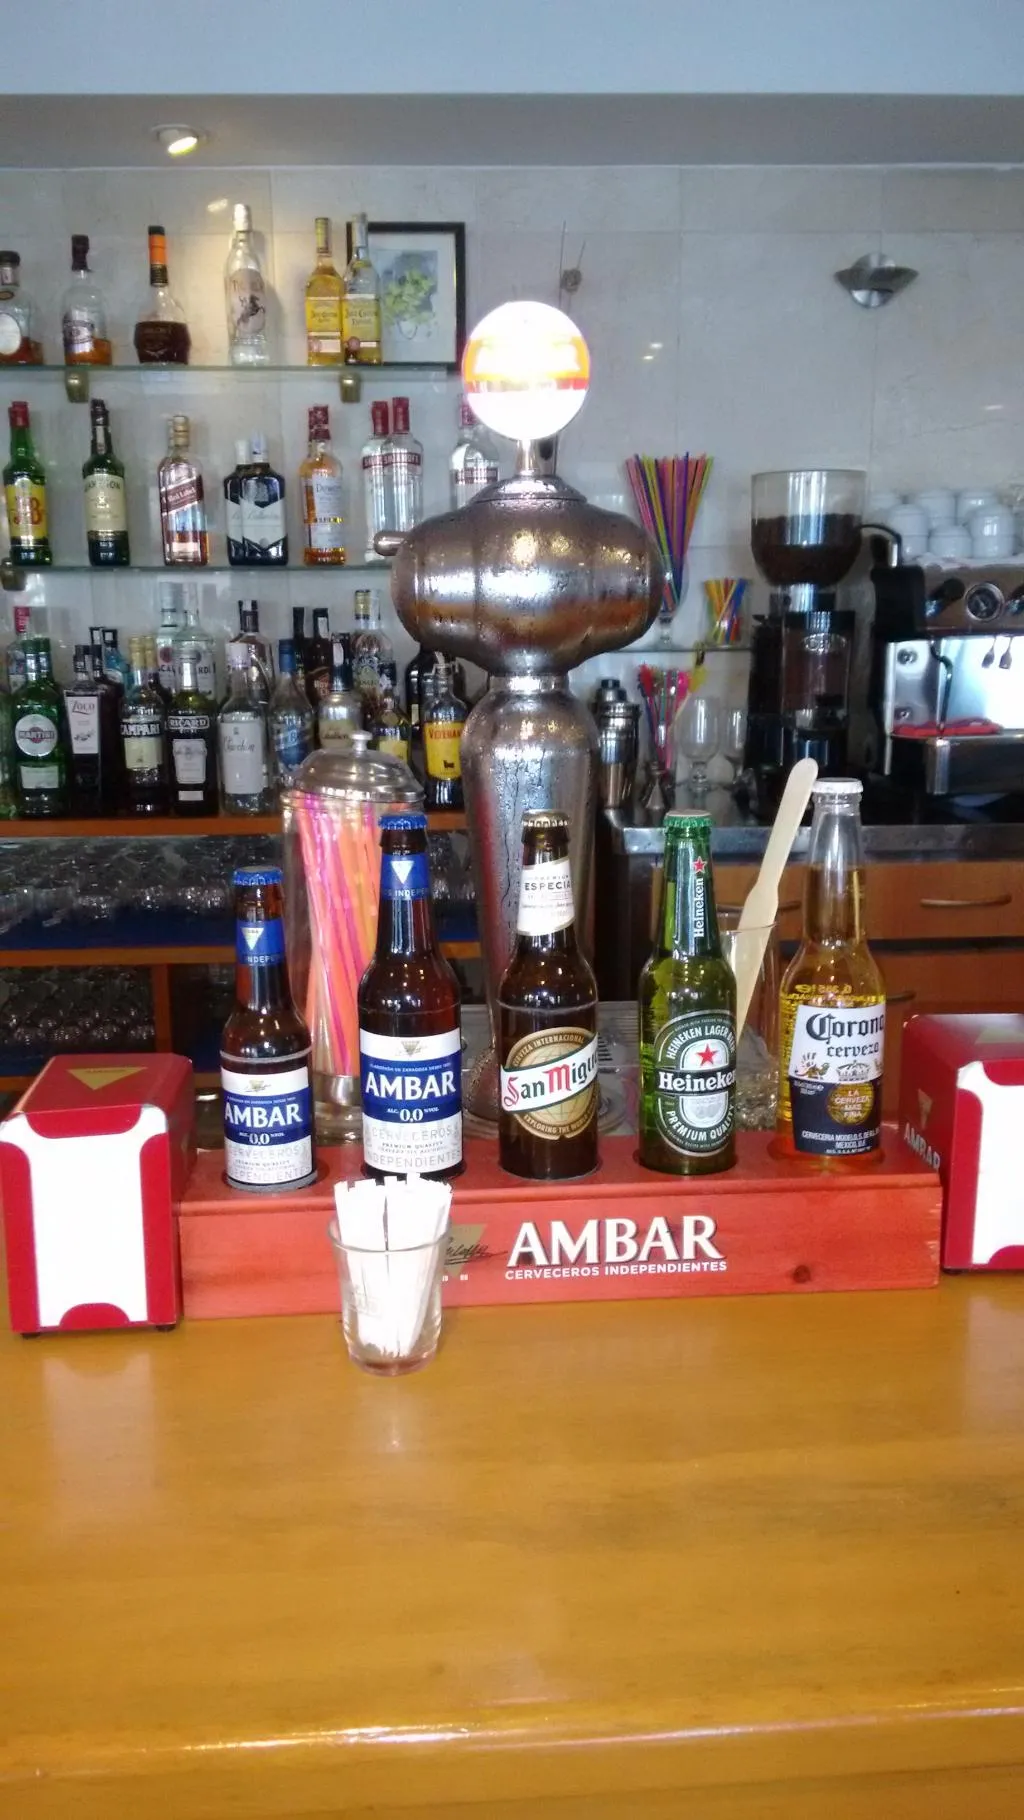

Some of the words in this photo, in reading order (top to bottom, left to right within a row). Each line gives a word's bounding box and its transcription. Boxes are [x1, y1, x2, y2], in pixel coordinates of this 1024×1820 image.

[384, 453, 419, 466] SMIOFF
[84, 480, 121, 492] JAMON
[121, 723, 160, 736] CAMPARI
[170, 719, 206, 728] RICARD
[19, 730, 55, 740] MARTINI
[428, 729, 462, 741] VETERAN
[524, 880, 572, 891] ESPECIA
[693, 877, 705, 938] Heineken
[533, 1033, 585, 1048] INTERNACIONAL
[666, 1025, 703, 1060] HEINEKEN
[705, 1024, 729, 1038] LAGER
[826, 1041, 879, 1058] cerveza
[365, 1070, 457, 1101] AMBAR
[503, 1075, 546, 1107] San
[542, 1052, 598, 1094] Migu
[224, 1101, 304, 1128] AMBAR
[523, 1114, 557, 1134] EXPLORING
[559, 1126, 570, 1134] THE
[666, 1110, 708, 1142] PREMIUM
[506, 1215, 726, 1268] AMBAR
[504, 1266, 600, 1281] CERVECEROS
[604, 1261, 728, 1276] INDEPENDIENTES
